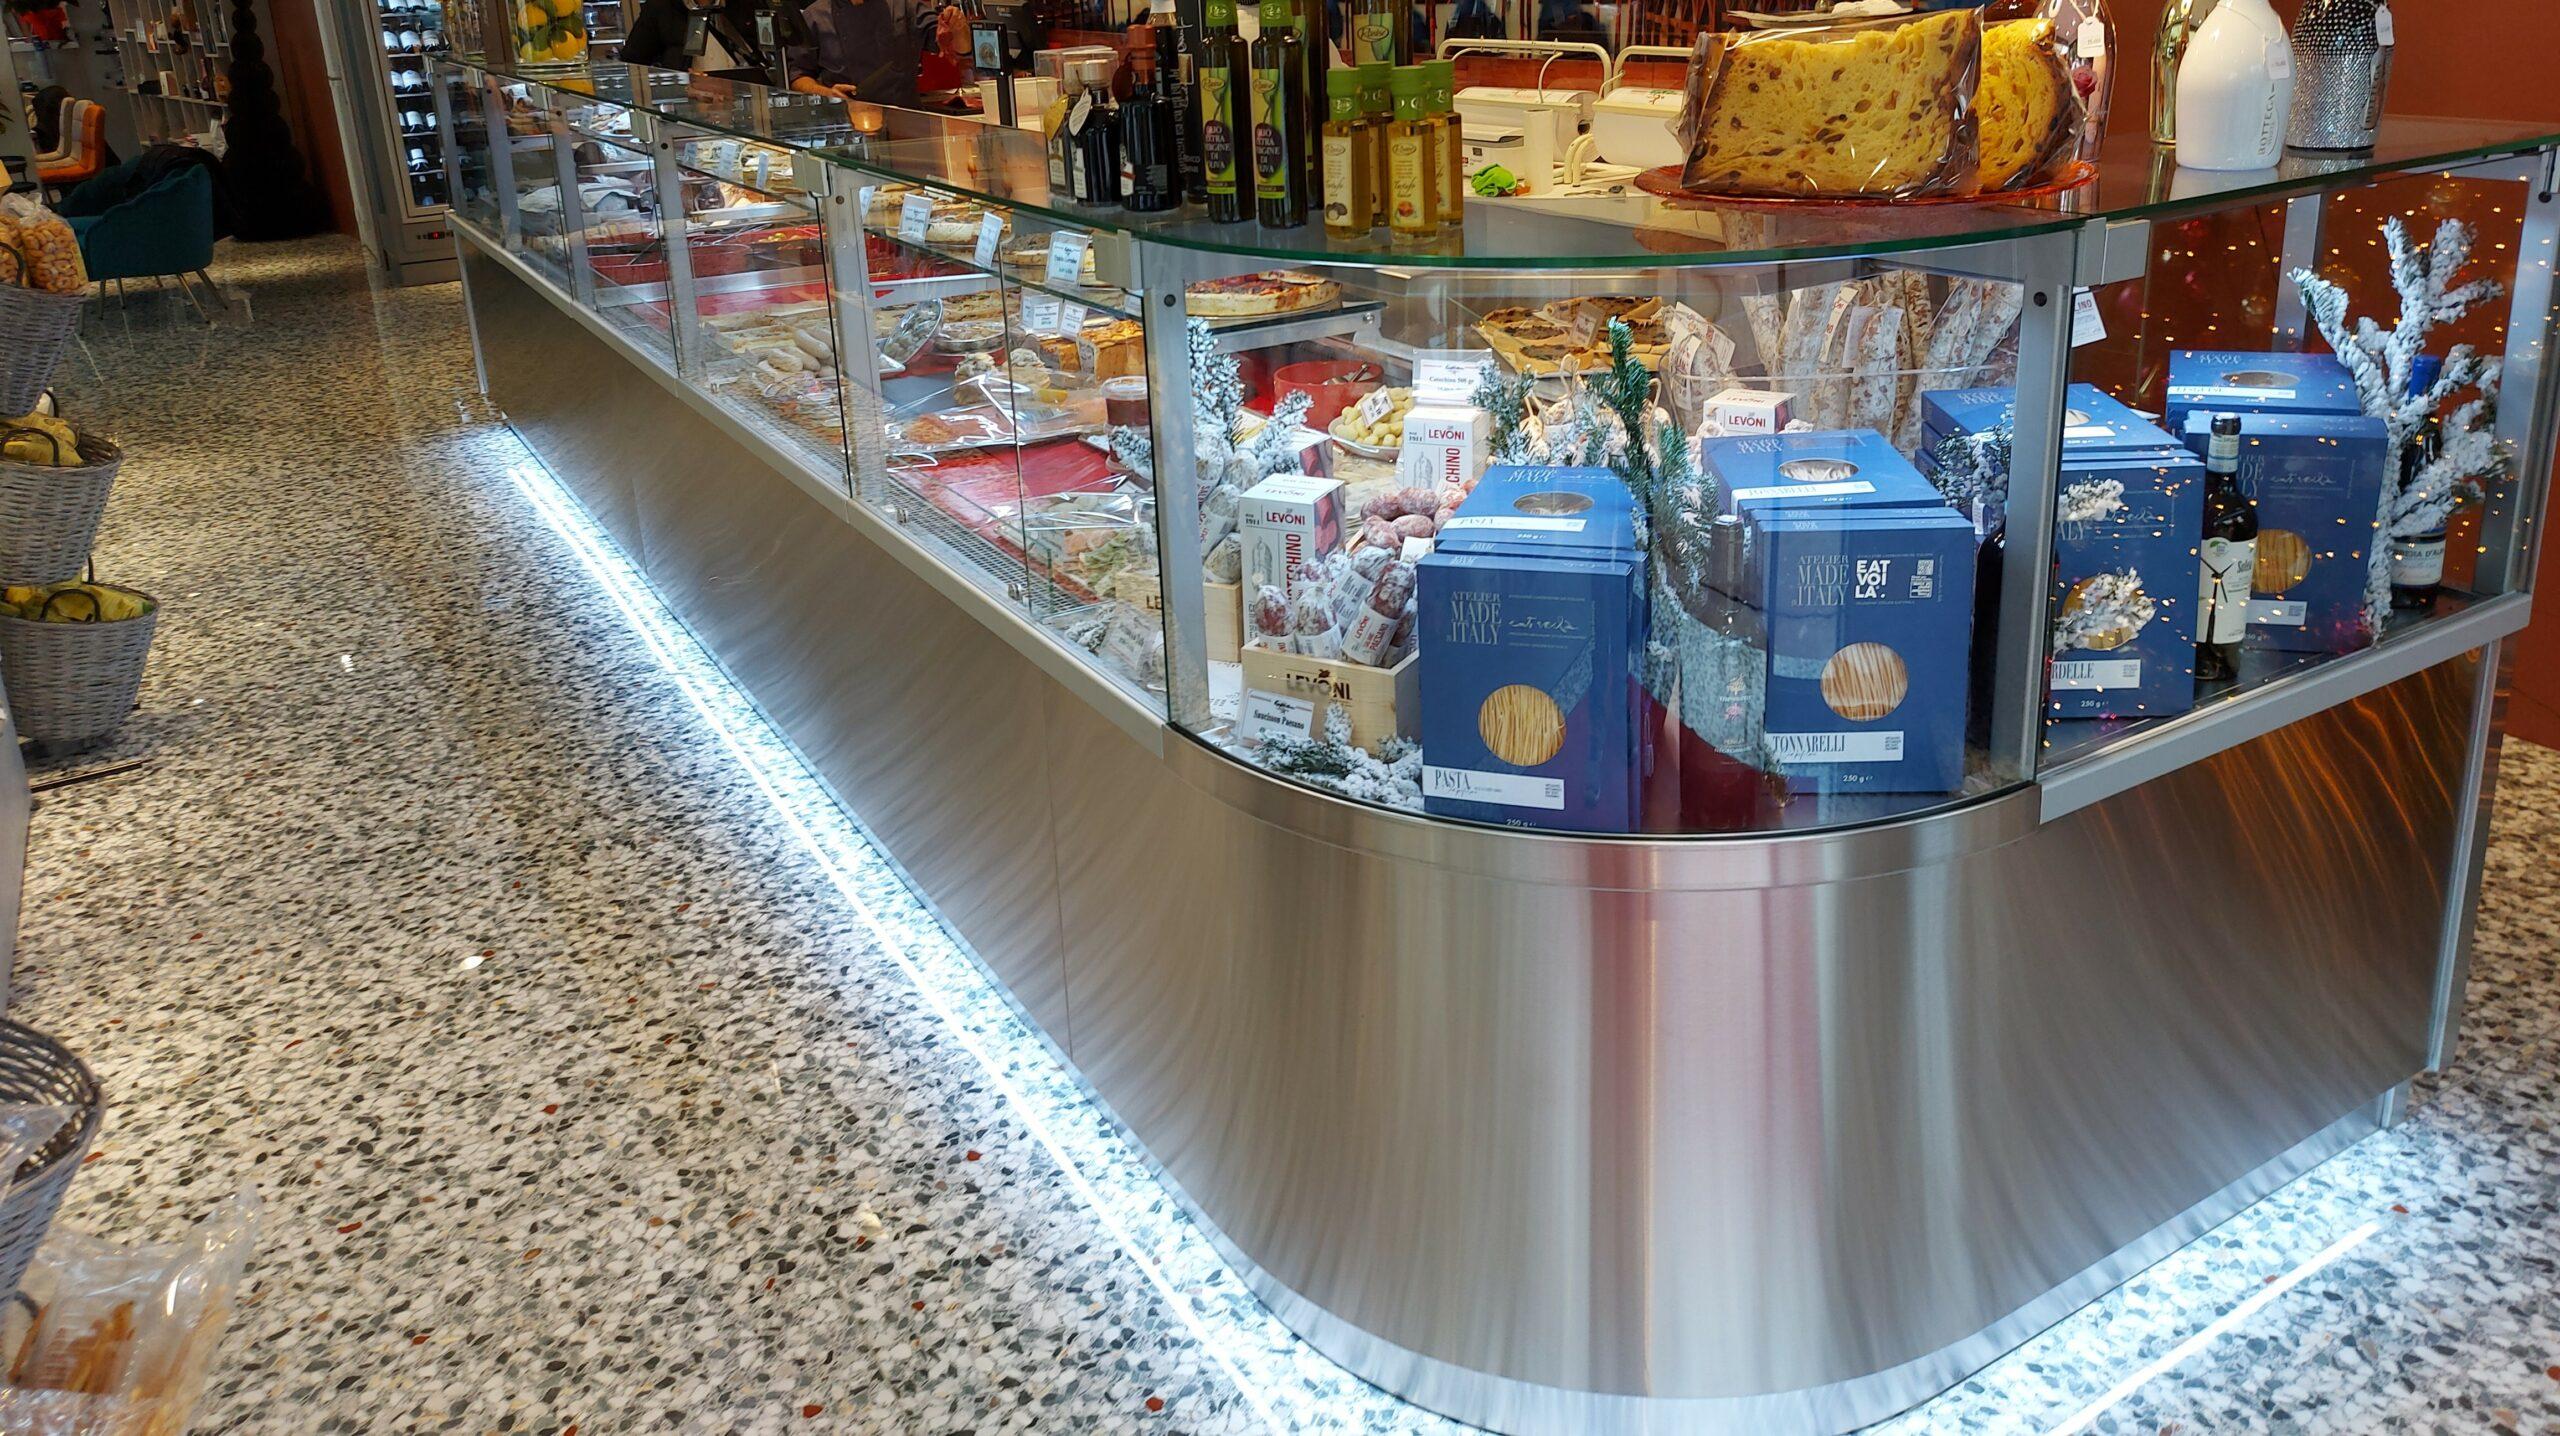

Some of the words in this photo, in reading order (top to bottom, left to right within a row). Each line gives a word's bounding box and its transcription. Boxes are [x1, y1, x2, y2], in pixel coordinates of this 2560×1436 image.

[2257, 94, 2275, 155] BOTTEGA
[1728, 414, 1766, 428] LEVONI
[1428, 429, 1465, 441] LEVONI
[1445, 447, 1461, 484] CHINO
[1245, 518, 1260, 526] 1911
[1265, 511, 1306, 526] LEVONI
[1798, 554, 1849, 565] ATELIER
[1856, 559, 1891, 573] EAT
[1797, 564, 1850, 586] MADE
[1857, 572, 1887, 586] VOI
[1451, 590, 1501, 602] ATELIER
[1797, 585, 1848, 607] ITALY
[1450, 601, 1502, 625] MADE
[1452, 621, 1501, 646] ITALY
[2051, 662, 2095, 680] RDELLE
[1285, 672, 1353, 702] LEVONI
[1281, 716, 1305, 730] Paesano
[1772, 734, 1846, 752] TONNARELLI
[1434, 768, 1471, 790] PASTA
[1842, 774, 1858, 782] 250
[1505, 818, 1522, 827] 250
